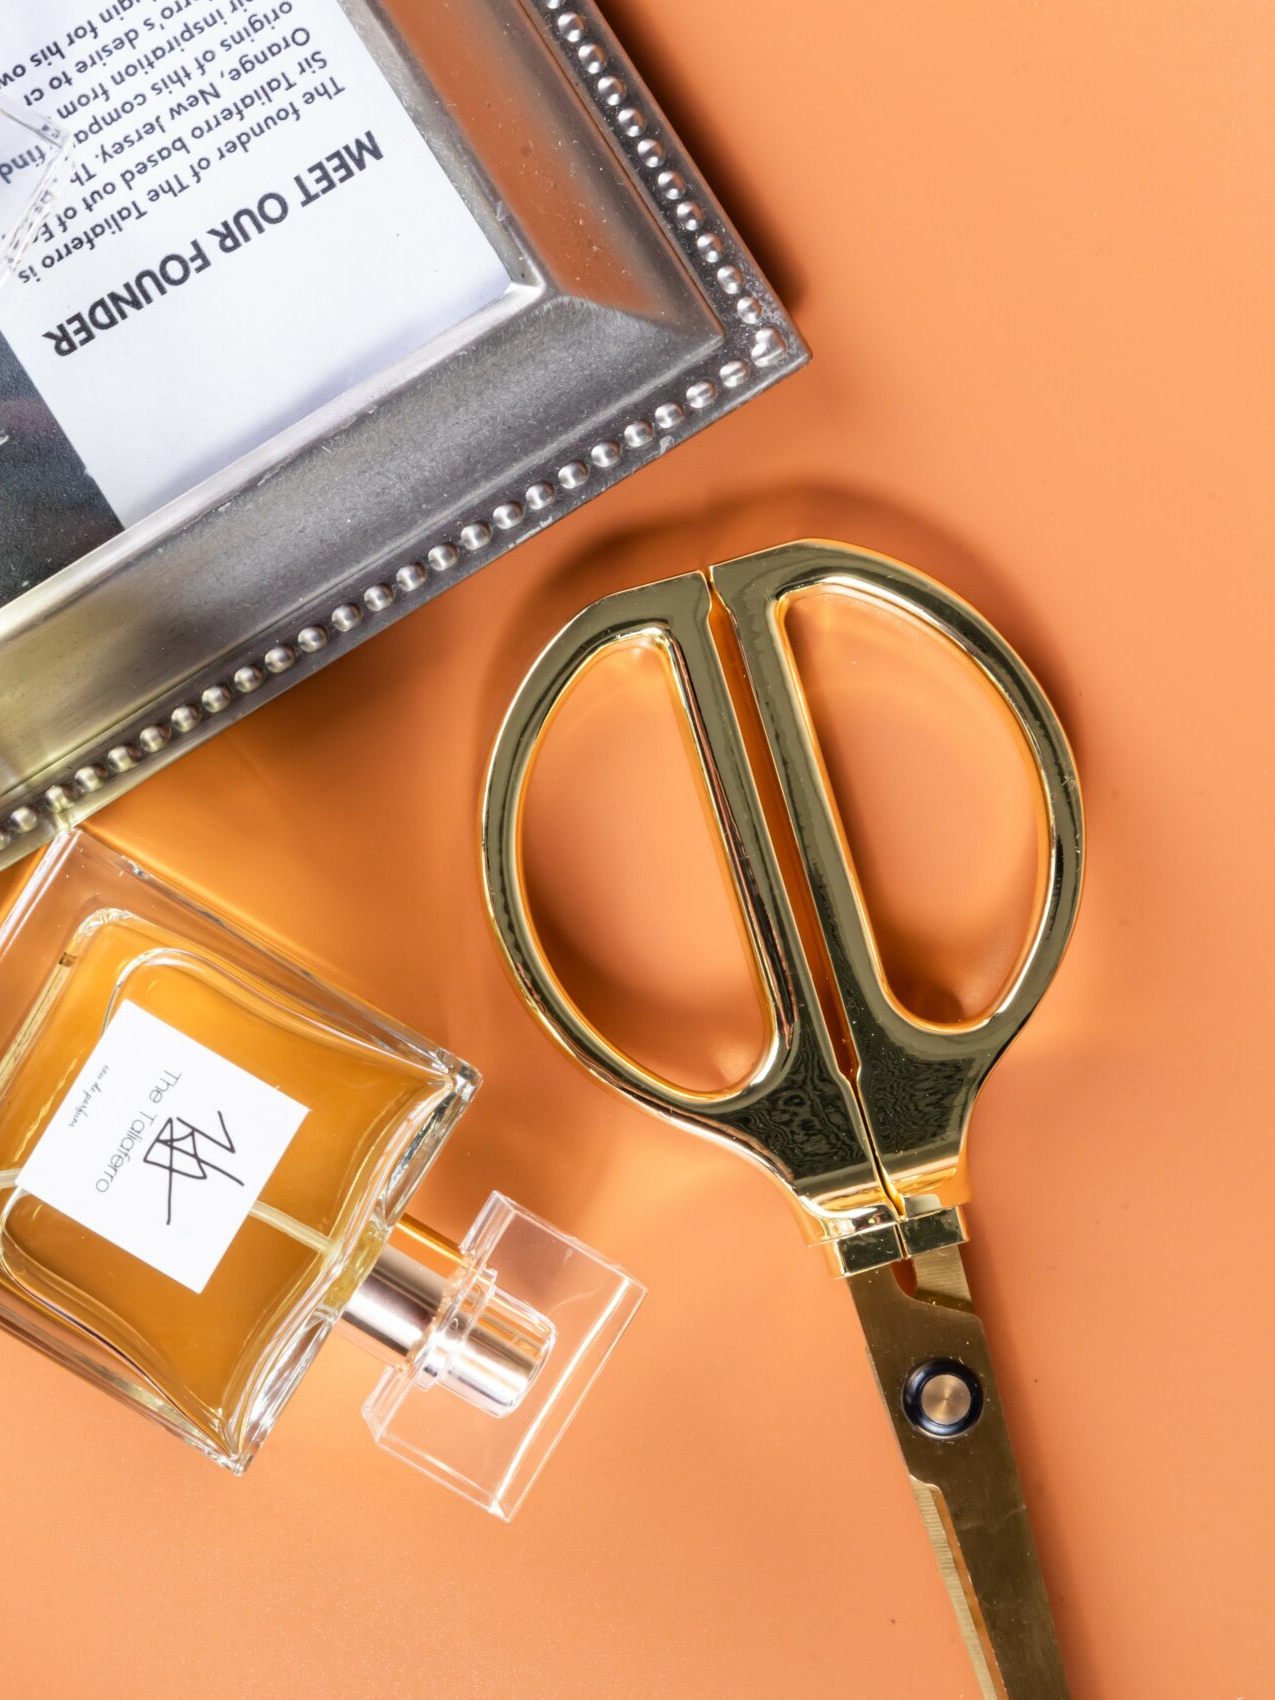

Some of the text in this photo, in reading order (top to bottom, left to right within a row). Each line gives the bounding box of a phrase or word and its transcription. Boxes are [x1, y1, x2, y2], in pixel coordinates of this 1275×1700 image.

[67, 20, 98, 46] for
[220, 2, 292, 52] origins
[30, 42, 65, 67] his
[75, 29, 139, 73] desire
[111, 9, 227, 85] inspiration
[194, 50, 215, 76] of
[297, 50, 328, 76] Sir
[49, 71, 73, 90] to
[151, 66, 191, 95] this
[303, 77, 345, 105] The
[57, 83, 109, 119] from
[70, 28, 310, 186] Orange, New Jersey. Th
[191, 72, 297, 139] Taliaferro
[72, 94, 147, 148] compa
[217, 102, 300, 160] founder
[120, 137, 190, 190] based
[189, 158, 211, 184] of
[81, 182, 116, 212] out
[147, 174, 189, 202] The
[41, 201, 147, 268] Taliaferro
[55, 207, 77, 233] of
[42, 130, 383, 356] MEET OUR FOUNDER
[17, 266, 41, 284] is
[96, 1070, 182, 1193] The Taliaferro
